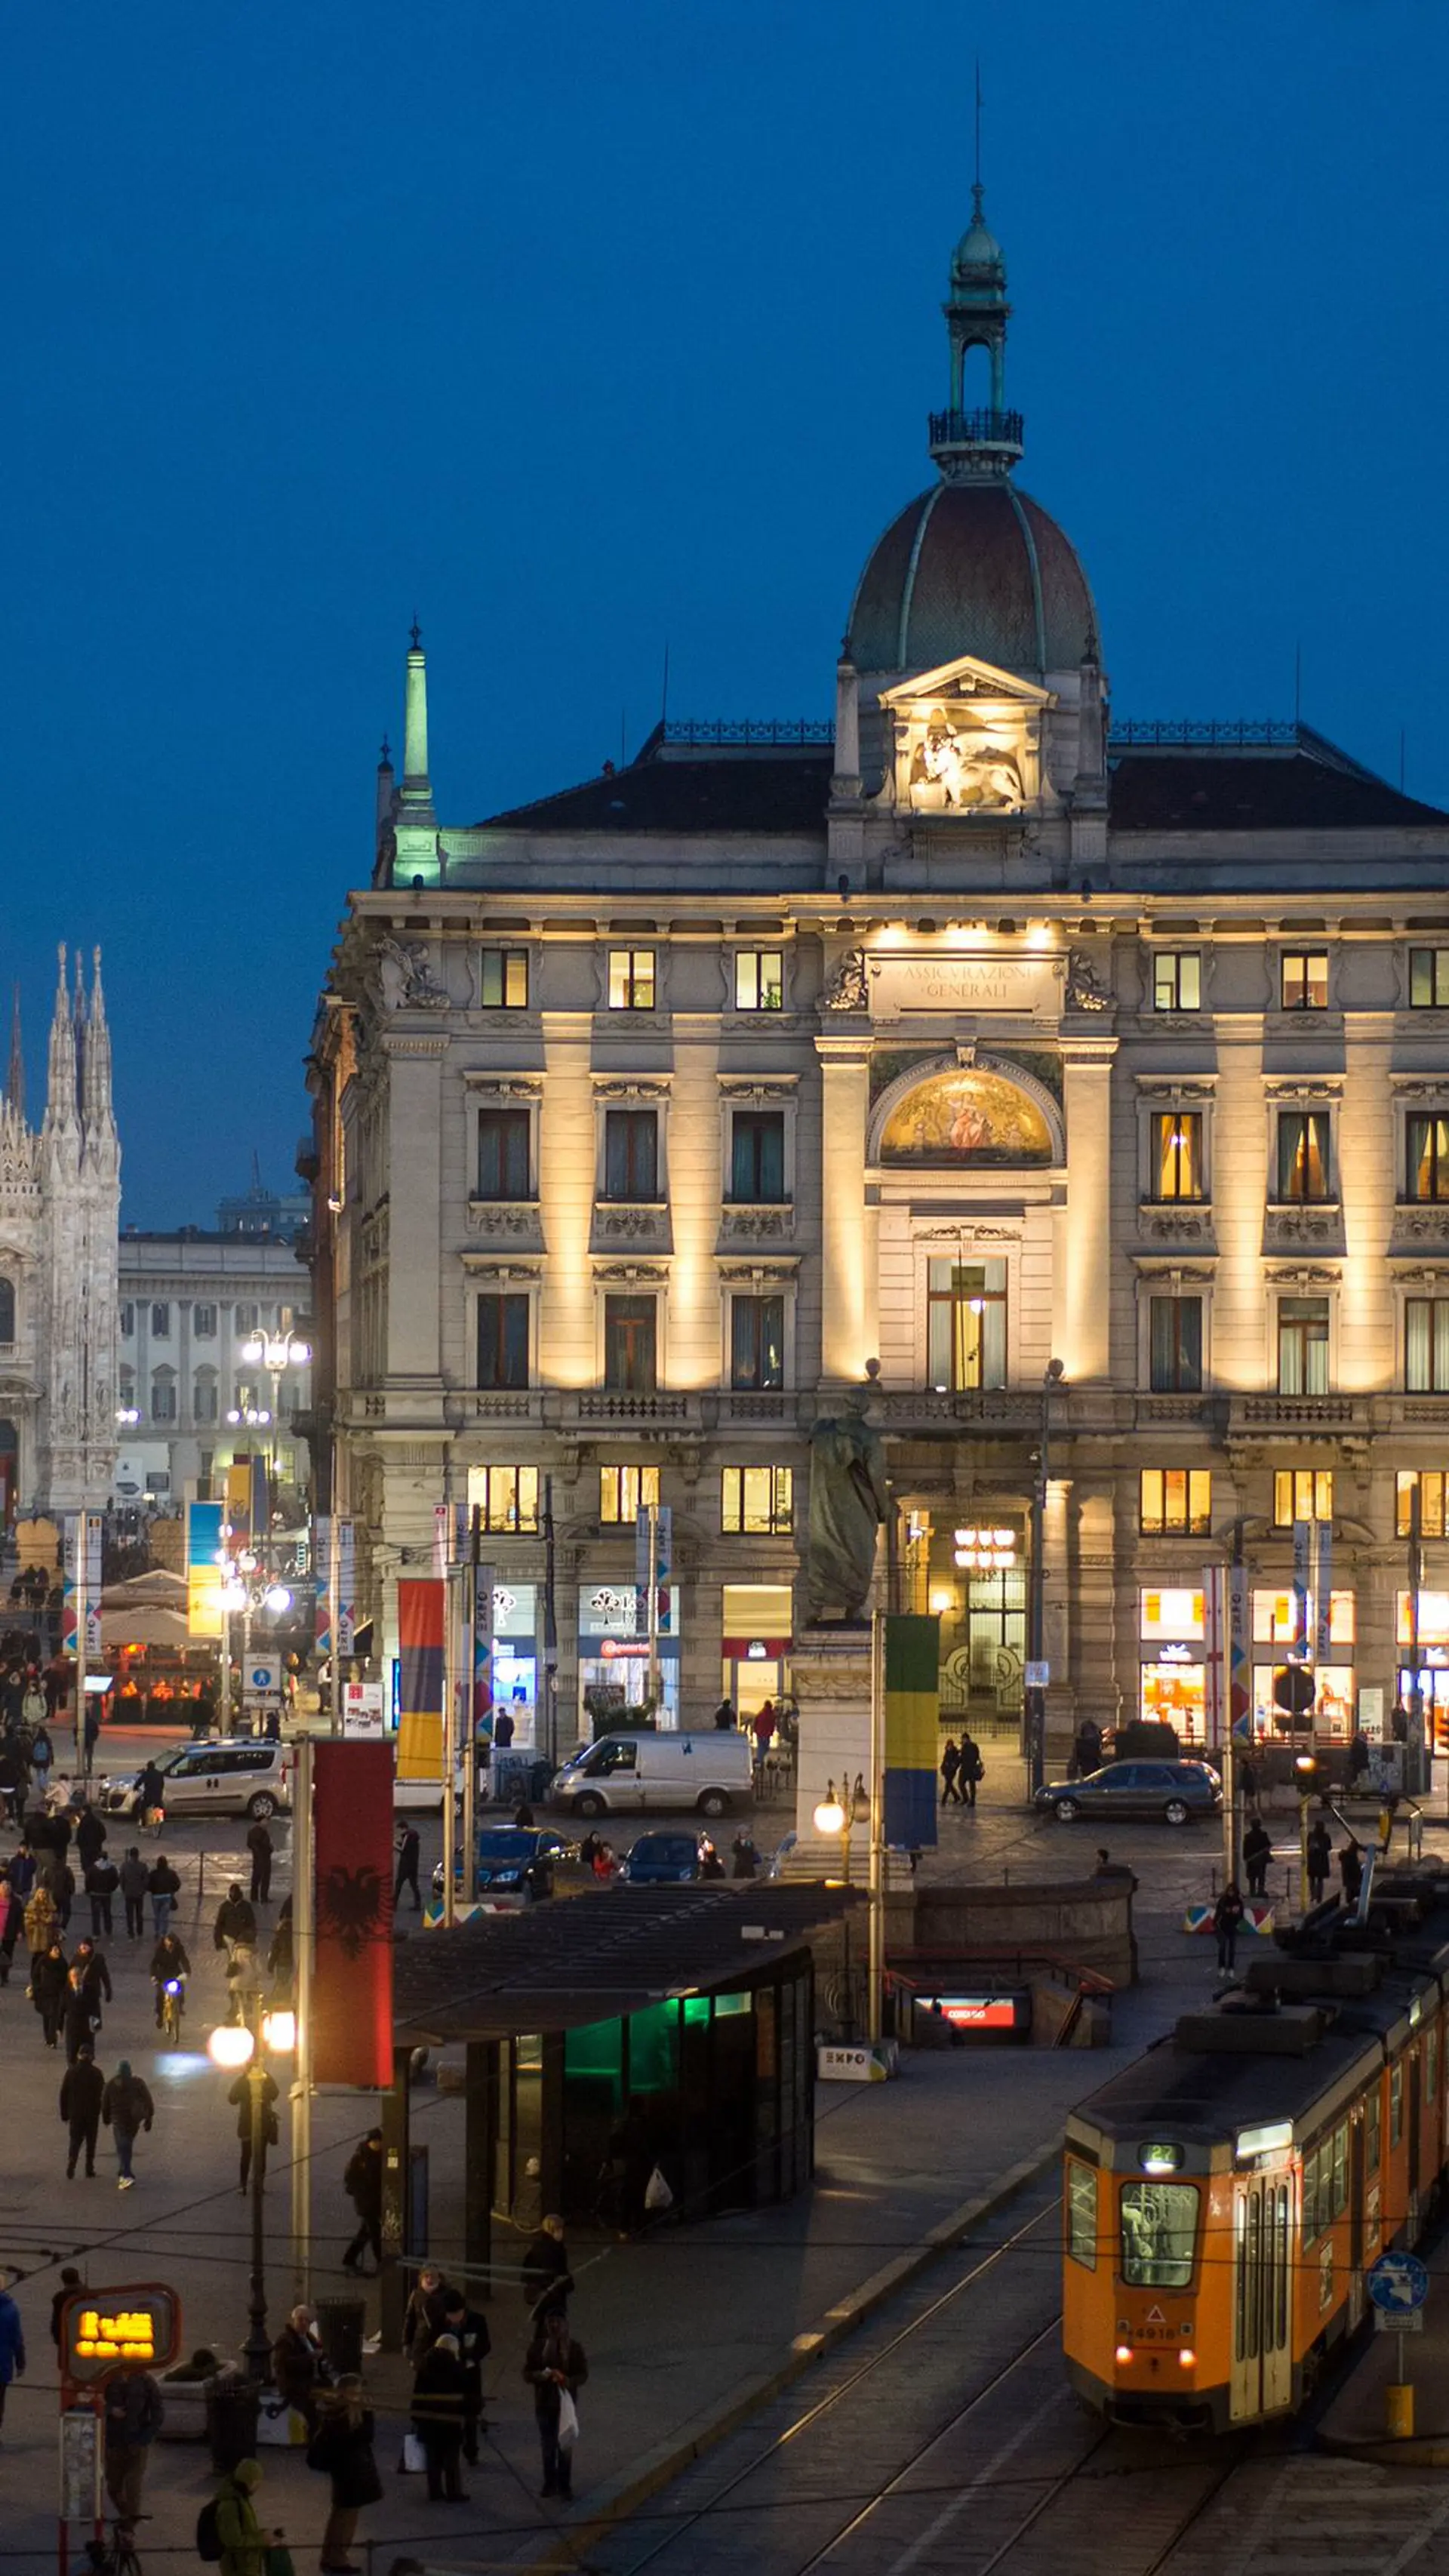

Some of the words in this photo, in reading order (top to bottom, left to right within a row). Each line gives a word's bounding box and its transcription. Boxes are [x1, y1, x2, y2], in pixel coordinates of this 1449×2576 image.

[927, 983, 1008, 999] GENERALI
[826, 2051, 865, 2065] EXPO
[1152, 2145, 1171, 2160] 27
